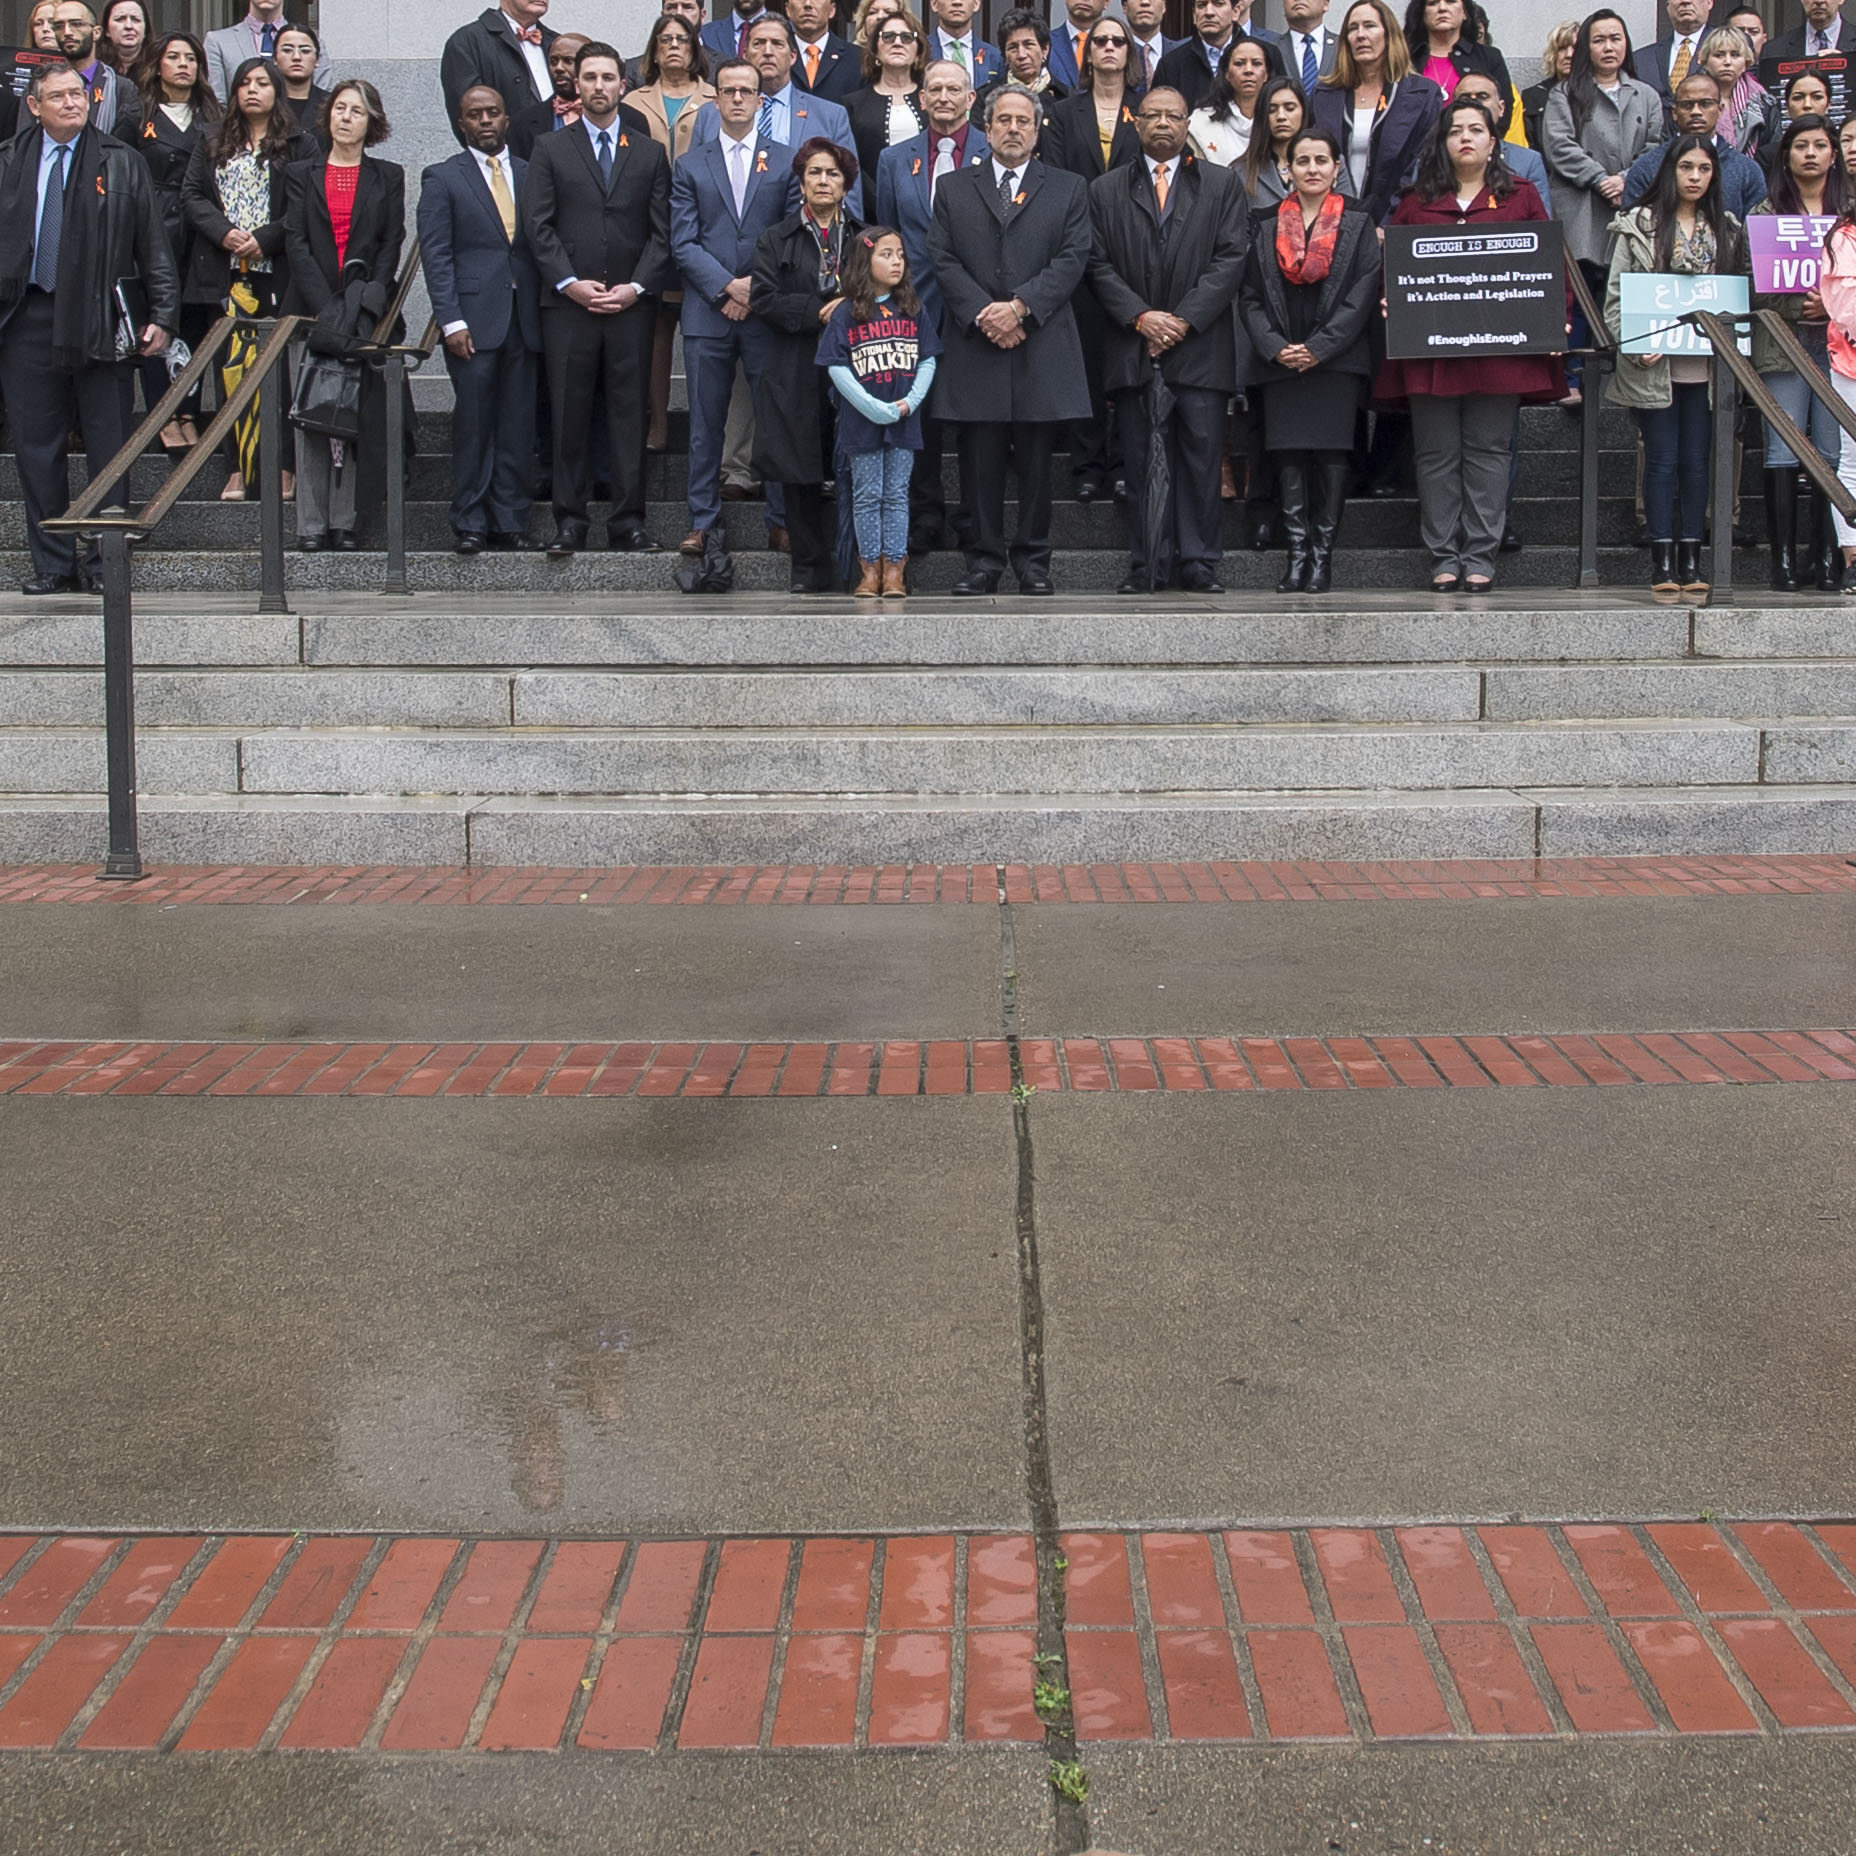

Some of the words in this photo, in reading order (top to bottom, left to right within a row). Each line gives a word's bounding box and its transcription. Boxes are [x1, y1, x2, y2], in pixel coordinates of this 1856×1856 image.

[1417, 240, 1463, 254] ENOUGH
[1467, 240, 1482, 251] IS
[1486, 237, 1532, 249] ENOUGH
[1417, 274, 1435, 285] not
[1437, 272, 1489, 286] Thoughts
[1490, 271, 1511, 282] and
[1512, 271, 1553, 284] Prayers
[1425, 291, 1461, 302] Action
[1463, 290, 1483, 300] and
[1485, 288, 1545, 302] Legislation
[1654, 278, 1719, 311] اقتراع
[1649, 319, 1712, 350] VOT
[851, 343, 894, 361] NATIONAL
